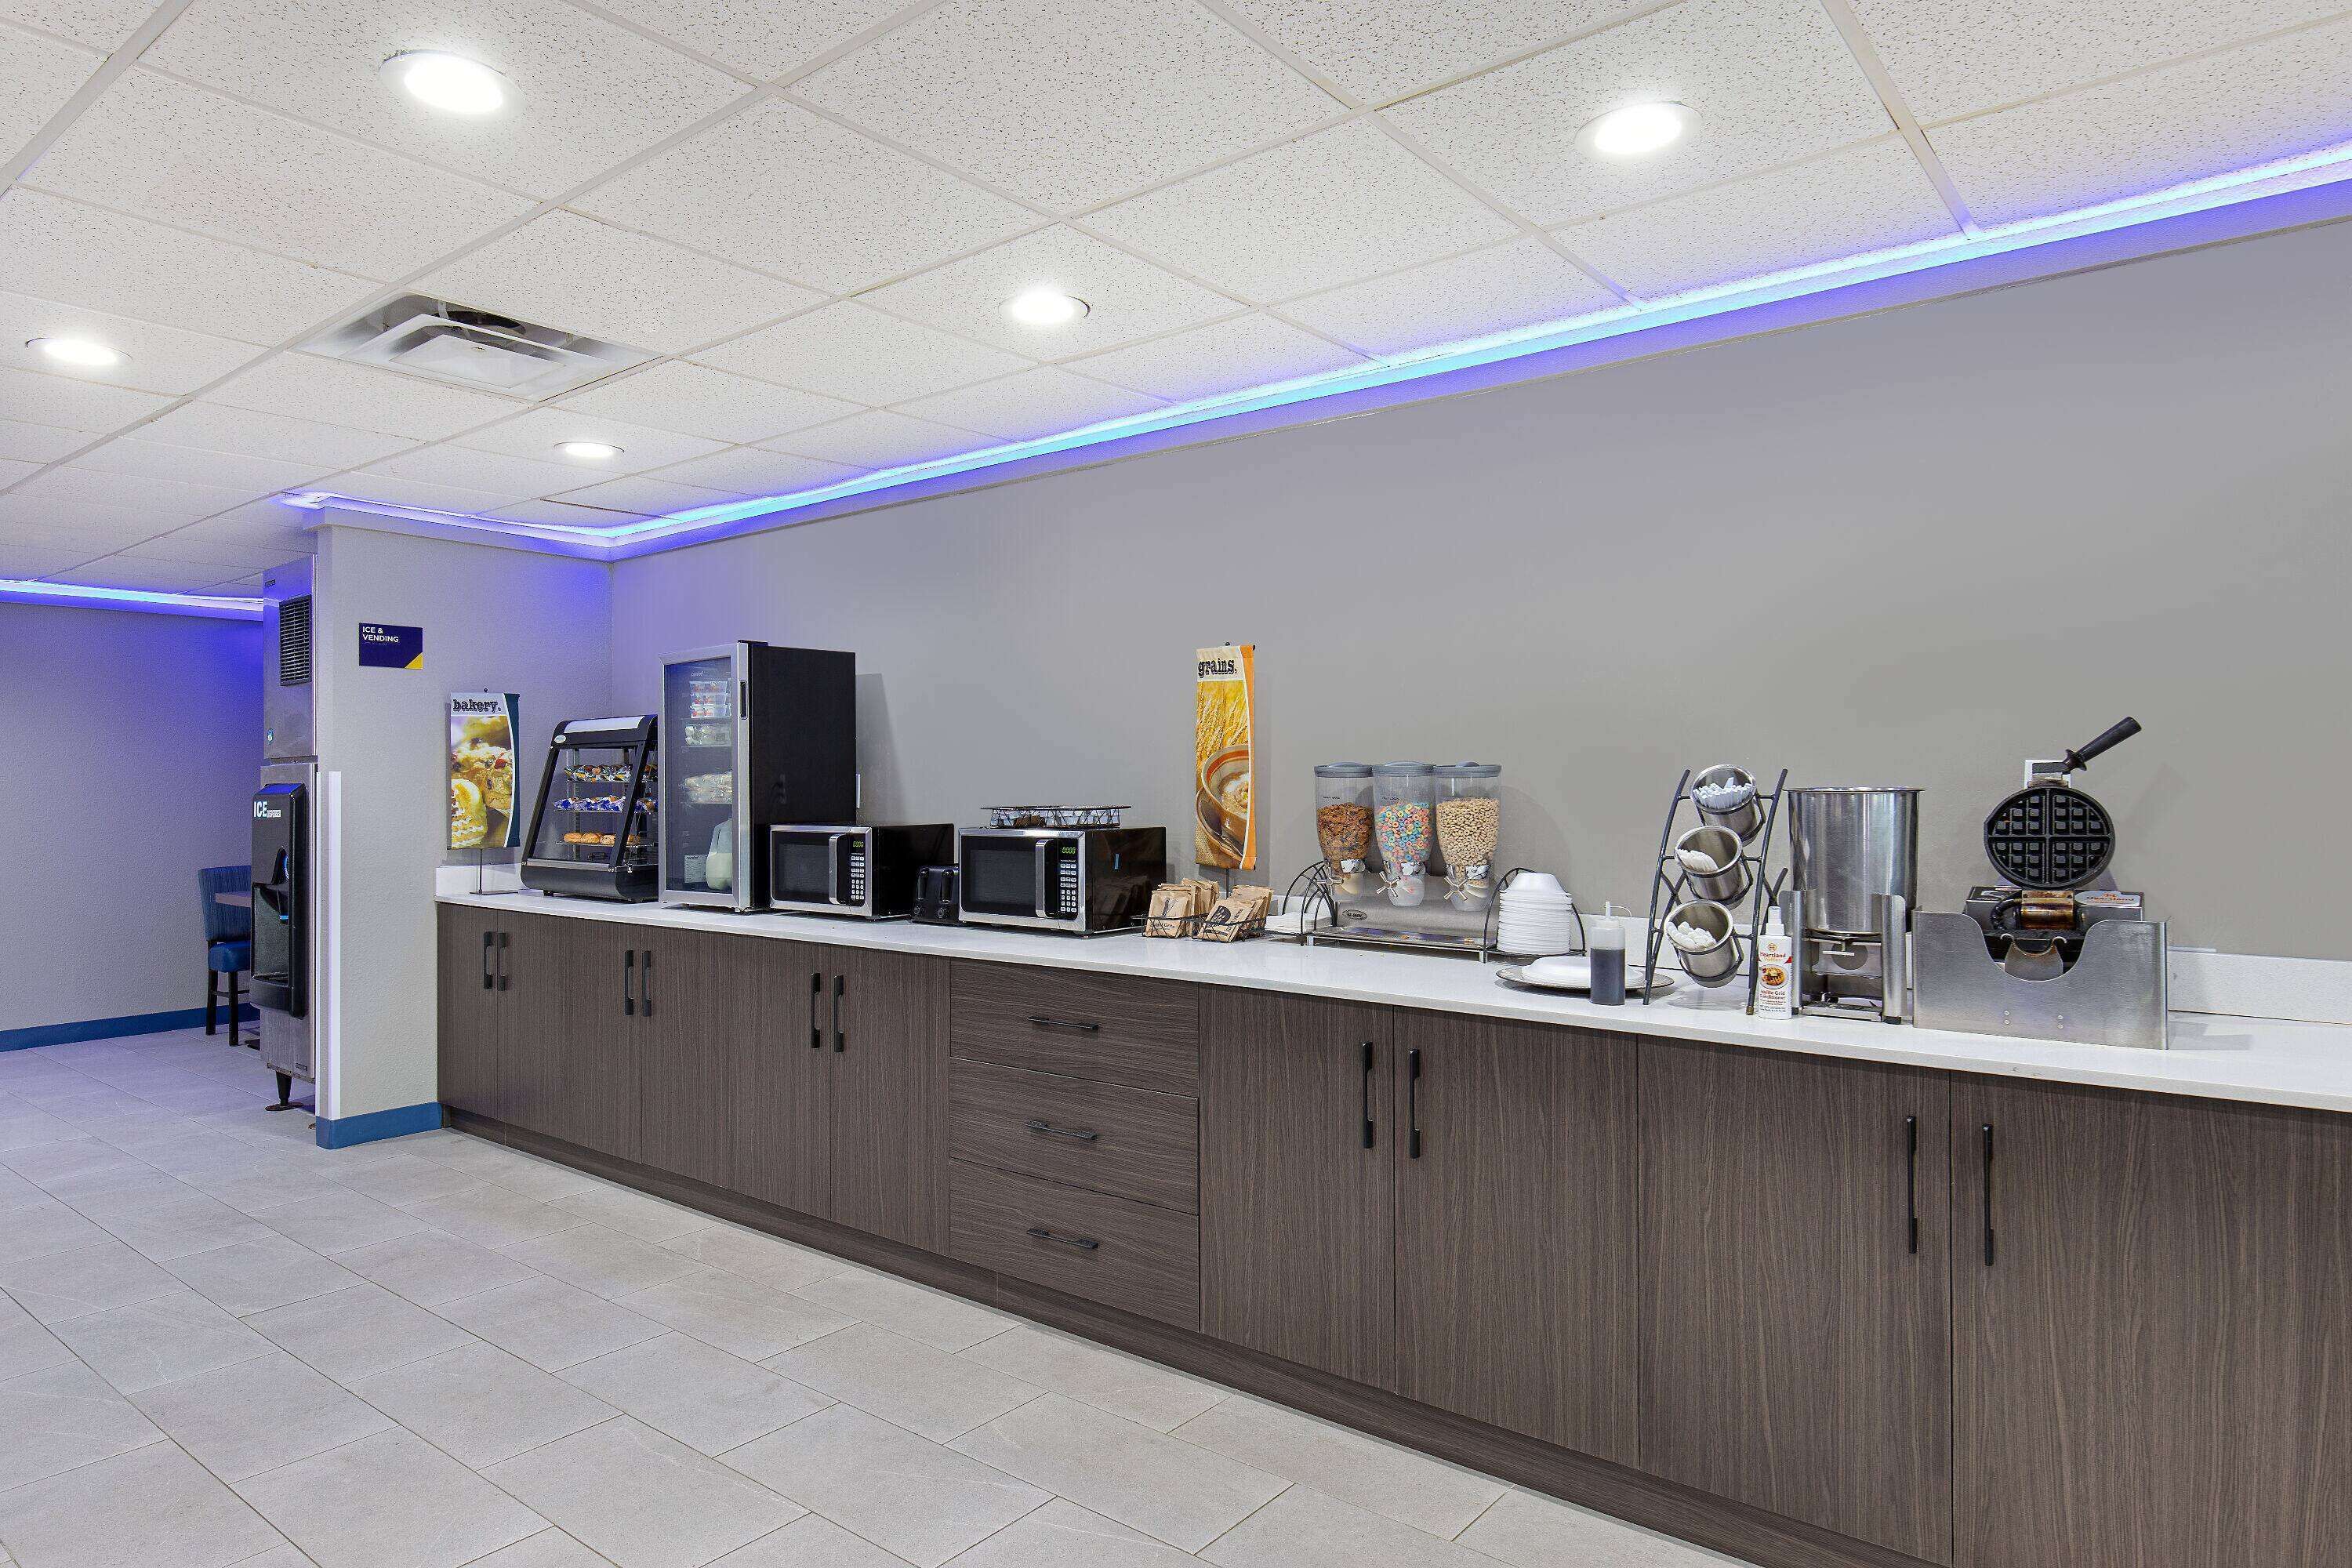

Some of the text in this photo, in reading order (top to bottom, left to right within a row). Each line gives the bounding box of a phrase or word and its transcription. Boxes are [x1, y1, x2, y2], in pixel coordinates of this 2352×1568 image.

[362, 634, 399, 643] VENDING
[1198, 658, 1237, 678] grains.
[452, 699, 502, 713] bakery.
[253, 800, 267, 818] ICE
